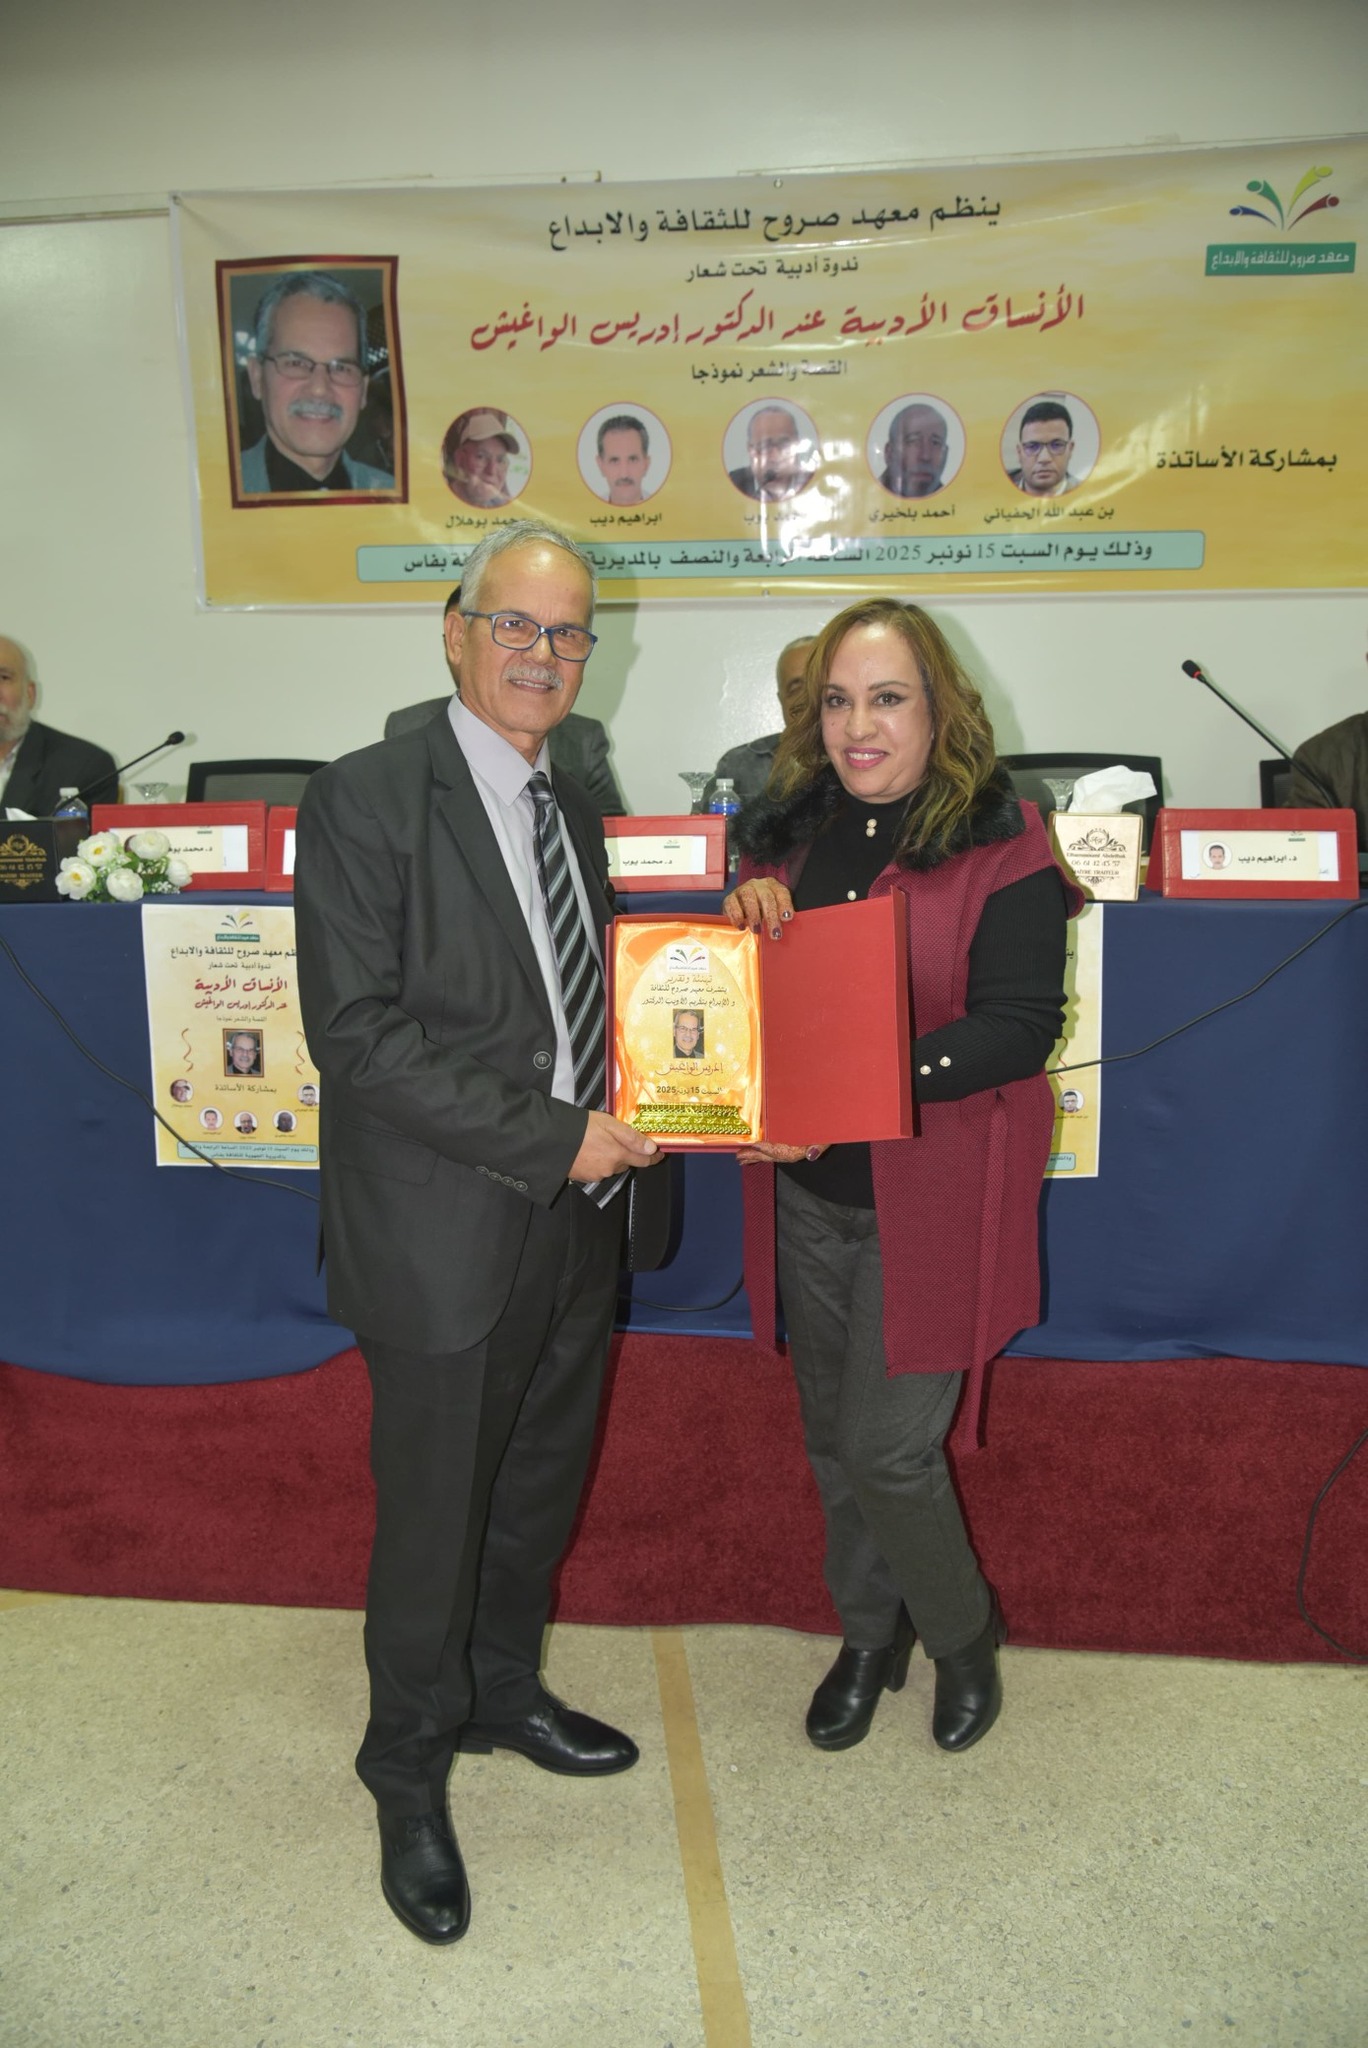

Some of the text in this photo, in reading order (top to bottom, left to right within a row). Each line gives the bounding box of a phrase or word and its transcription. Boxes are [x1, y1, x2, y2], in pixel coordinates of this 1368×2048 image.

[548, 195, 1001, 251] ينظم معهد صروح للثقافة والابداع
[1250, 249, 1289, 265] للثقافة
[1289, 252, 1316, 269] صروح
[1317, 250, 1350, 264] معهد
[685, 255, 860, 283] ندوة أدبية تحت شعار
[470, 283, 1084, 351] الأنساق الأدبية عند الدكتور إدريس الواغيش
[691, 363, 744, 384] نموذجا
[1156, 445, 1337, 472] بمشاركة الأساتذة
[921, 503, 956, 518] أحمد
[1068, 506, 1094, 521] عبد
[1096, 506, 1115, 519] بن
[445, 515, 487, 529] بوهلال
[589, 512, 662, 527] ابراهيم ديب
[874, 545, 922, 562] 2025
[925, 545, 972, 566] نونبر
[977, 543, 996, 559] 15
[1000, 543, 1058, 564] السبت
[1063, 544, 1099, 562] يوم
[1102, 540, 1153, 561] وذلك
[404, 553, 447, 572] بفاس
[669, 550, 740, 570] والنصف
[1238, 855, 1256, 864] ديب
[1257, 854, 1287, 863] ابراهيم
[205, 947, 234, 955] للثقافة
[236, 949, 260, 959] صروح
[262, 948, 282, 958] معهد
[242, 976, 287, 993] الأنساق
[656, 1086, 676, 1094] 2025
